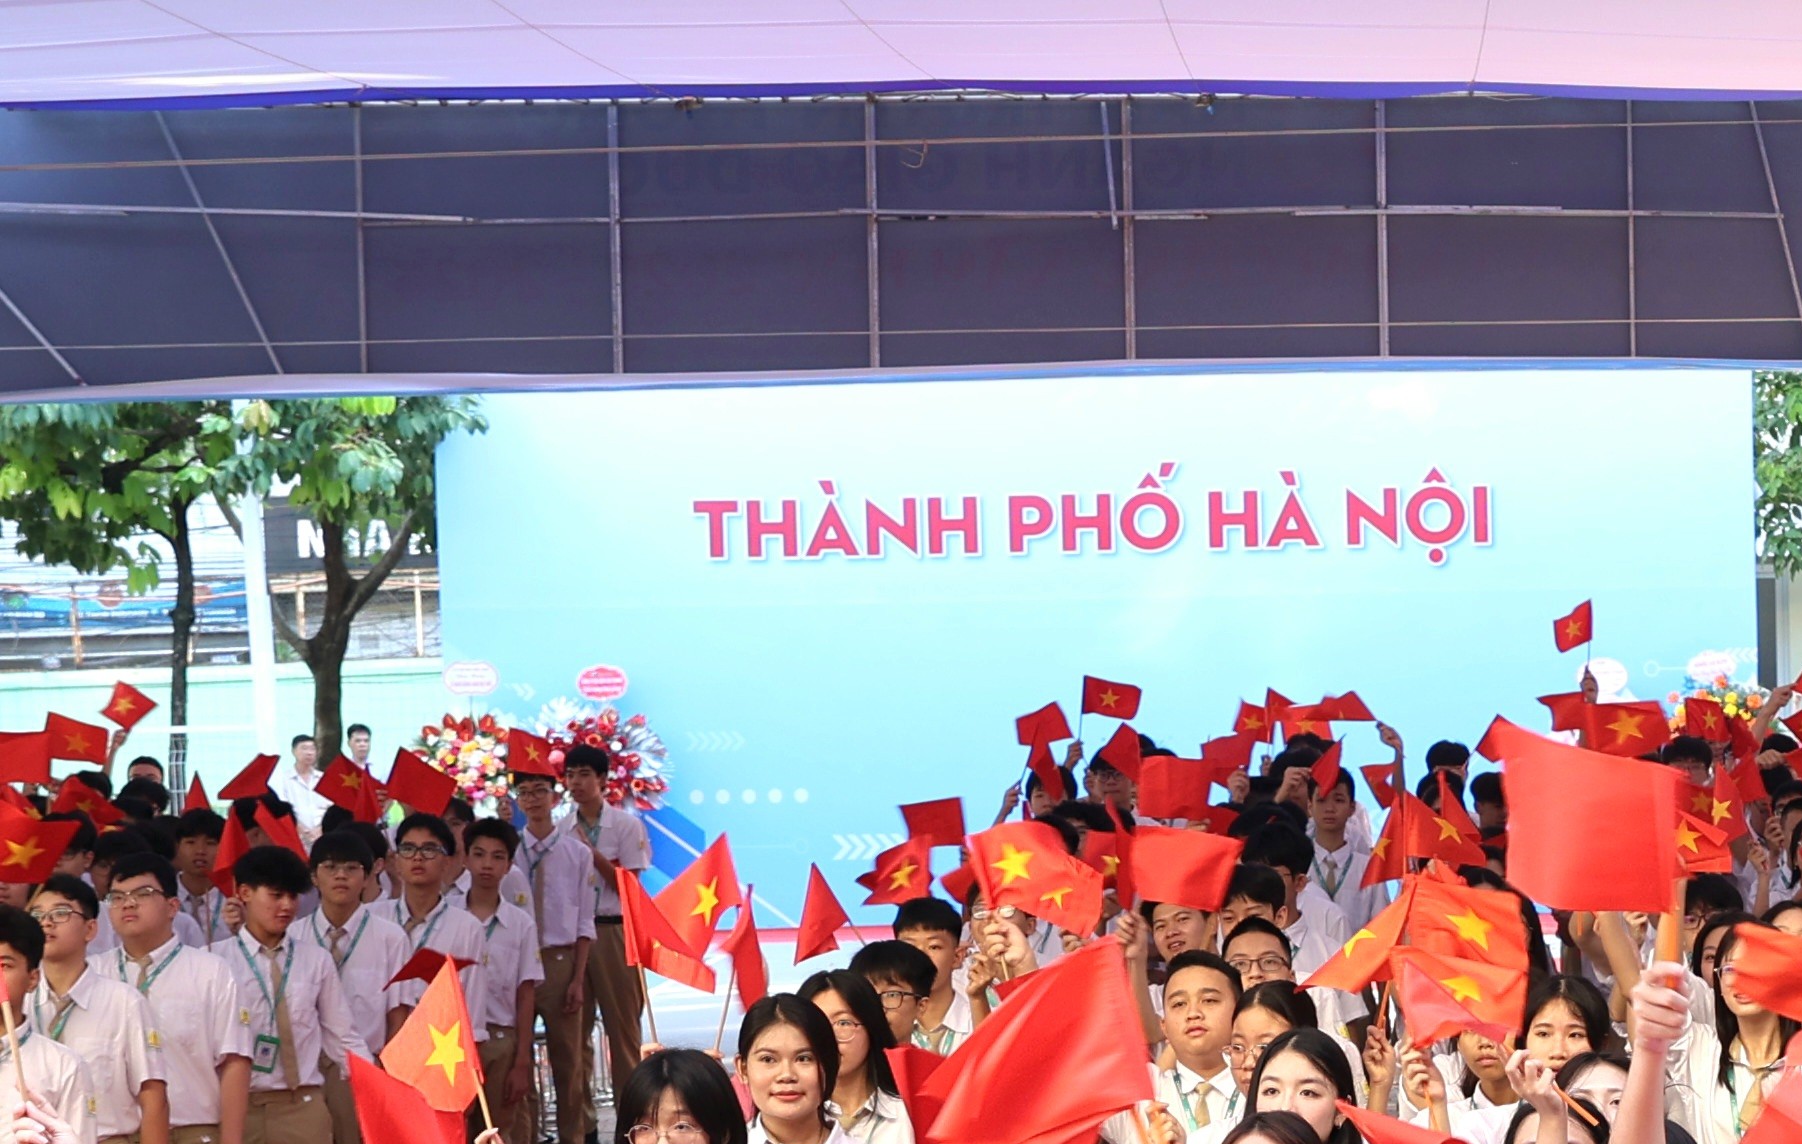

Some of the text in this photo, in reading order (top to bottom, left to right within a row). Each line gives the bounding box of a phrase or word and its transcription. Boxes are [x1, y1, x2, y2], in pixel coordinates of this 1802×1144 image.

[694, 463, 1488, 563] THÀNH PHỐ HÀ NỘI
